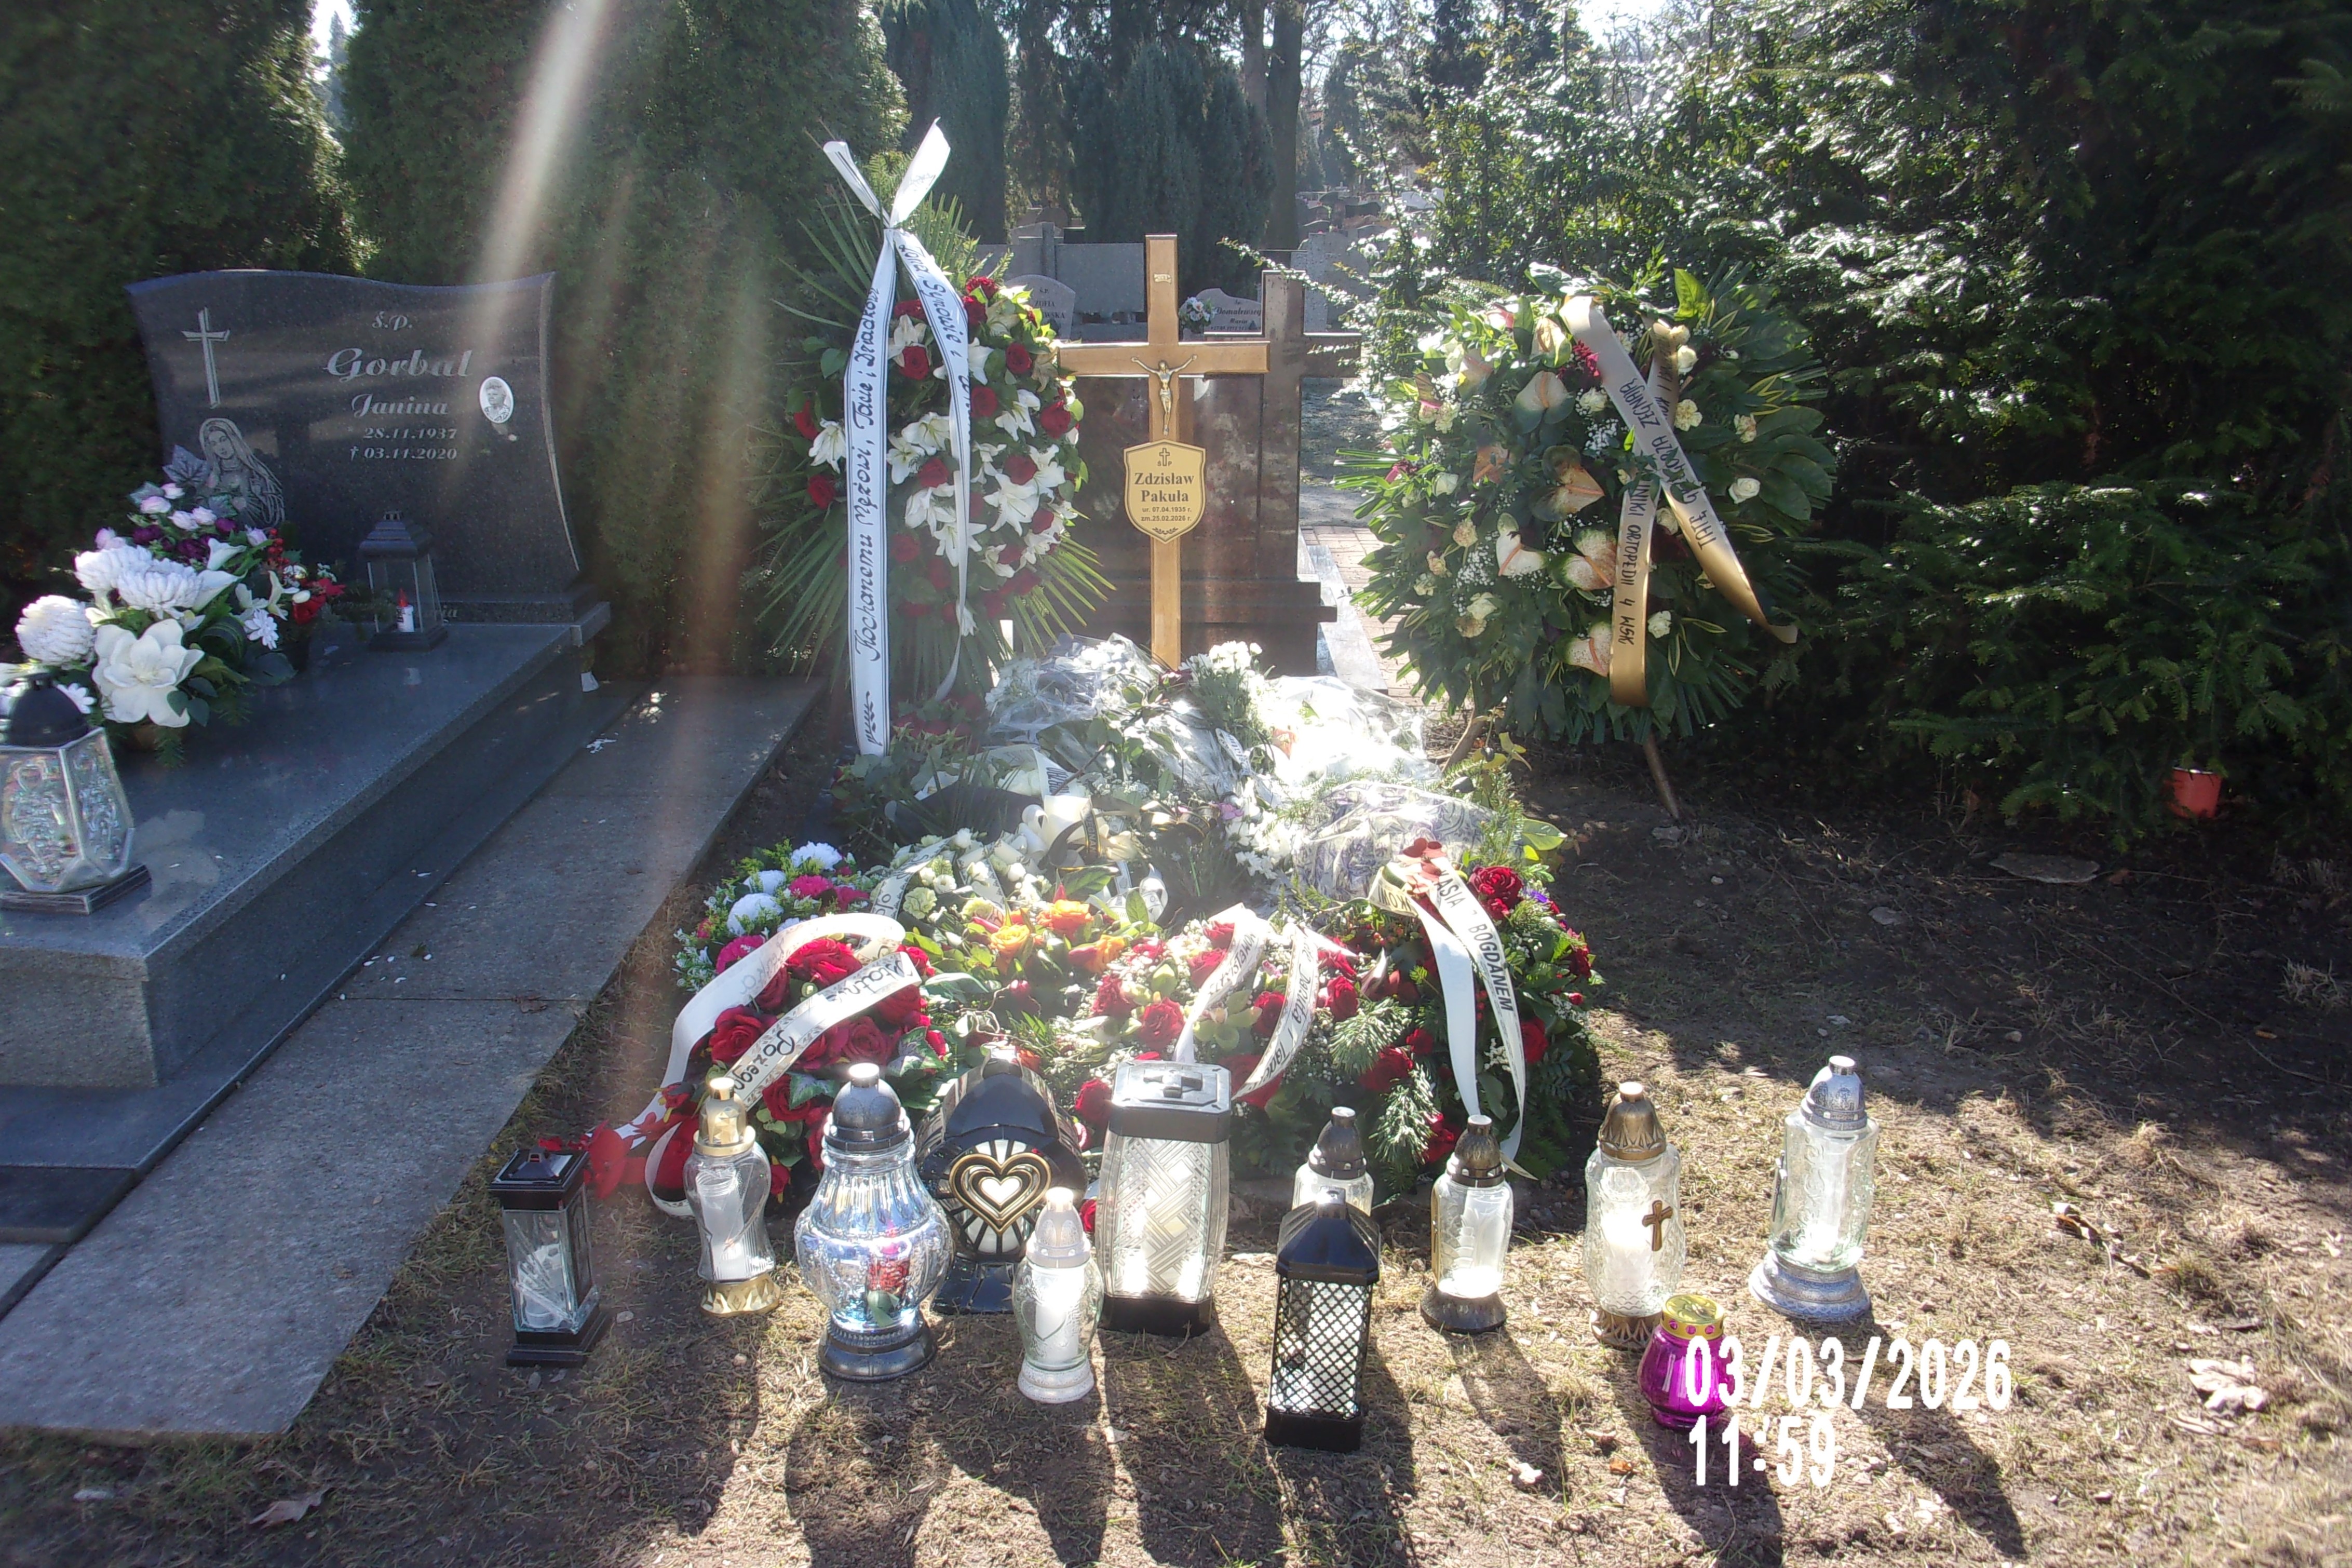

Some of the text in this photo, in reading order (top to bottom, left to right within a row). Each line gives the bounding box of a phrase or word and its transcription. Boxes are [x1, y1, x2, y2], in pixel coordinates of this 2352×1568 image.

[322, 348, 472, 382] Gorbal
[352, 394, 449, 417] Janina
[852, 383, 874, 429] Tacie
[363, 427, 457, 439] 28.11.1937
[364, 448, 457, 459] 03.11.2020
[1134, 472, 1194, 485] Zdzisław
[1140, 490, 1189, 502] Pakuła
[1620, 524, 1641, 586] ORTOPEDII
[853, 533, 881, 661] Kochanemu
[1618, 599, 1635, 607] 4
[1617, 616, 1635, 645] WSK
[1467, 923, 1514, 1012] BOGDANEM
[732, 1030, 795, 1091] Pożegn
